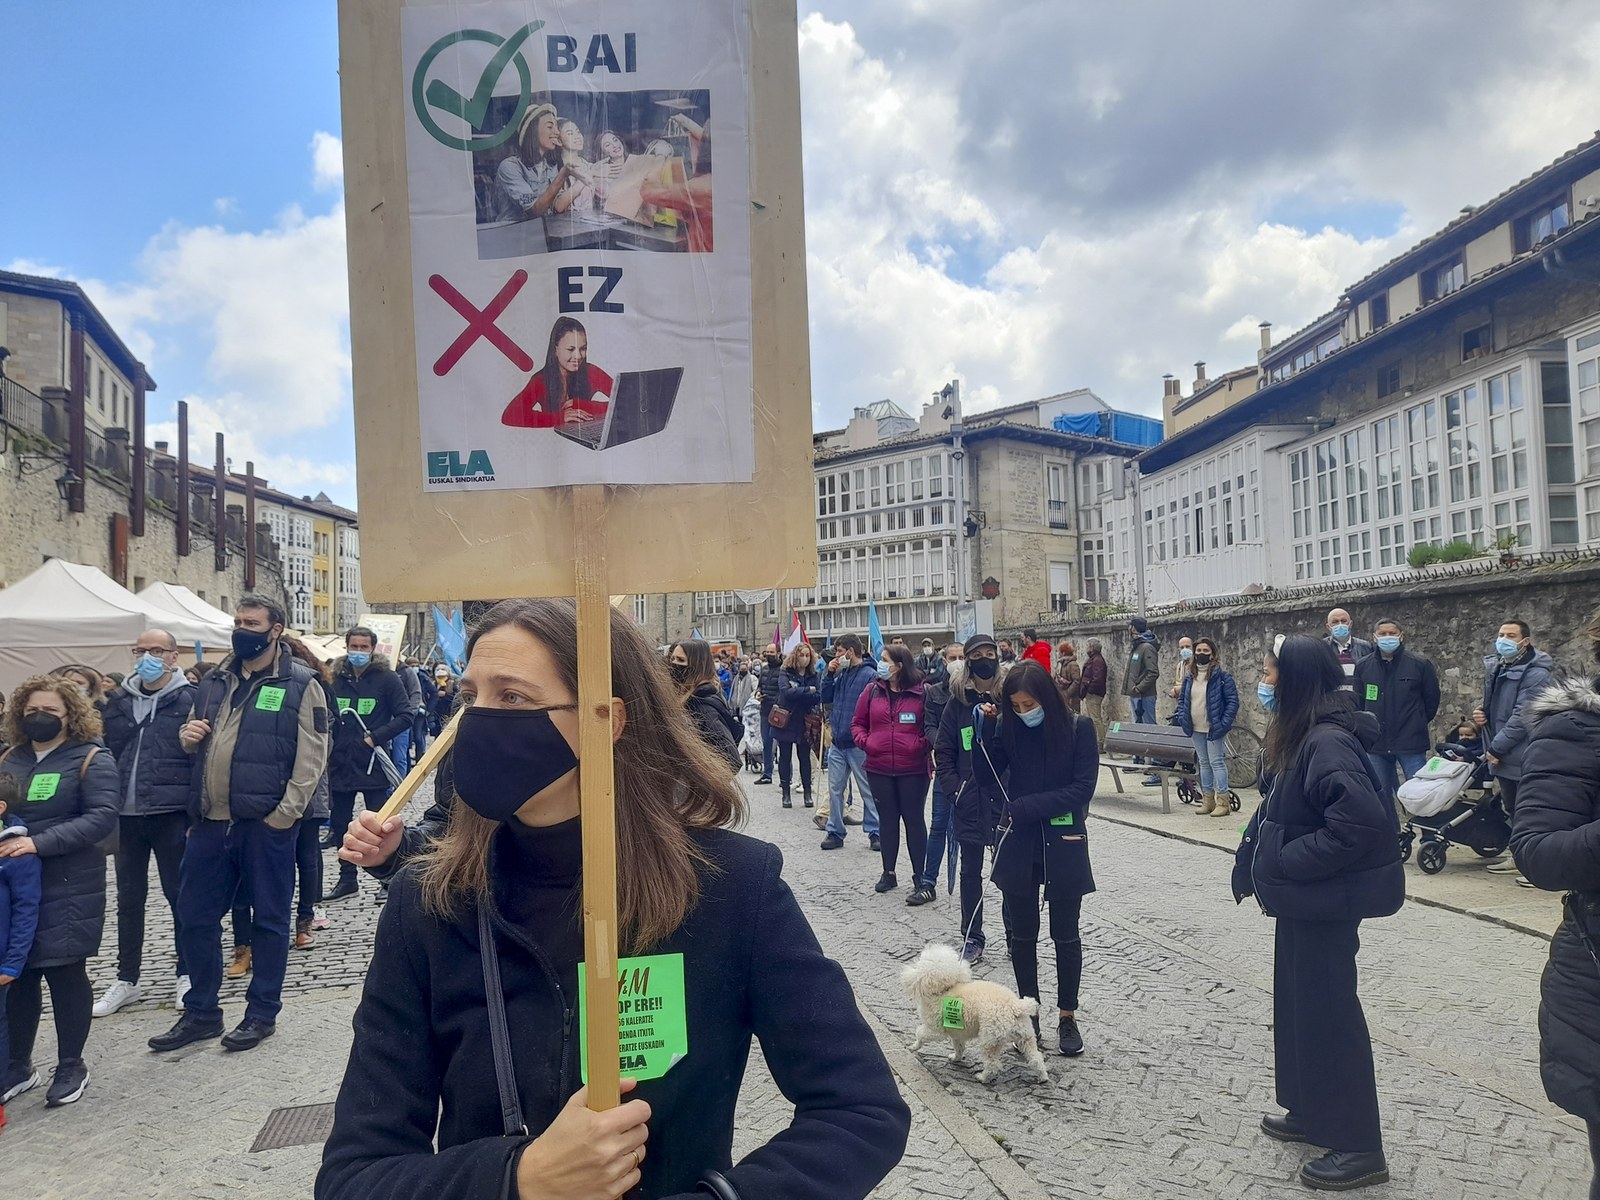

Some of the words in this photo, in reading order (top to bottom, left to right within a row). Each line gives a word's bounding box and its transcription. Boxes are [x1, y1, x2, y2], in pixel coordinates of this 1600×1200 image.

[546, 32, 637, 73] BAI
[558, 266, 625, 314] EZ
[427, 450, 495, 477] ELA
[618, 1000, 632, 1014] OP
[634, 997, 663, 1012] ERE!!
[626, 1014, 654, 1026] KALERATZE
[619, 1029, 637, 1040] DENDA
[637, 1027, 655, 1038] ITXITA
[619, 1042, 638, 1053] ERATZE
[638, 1039, 665, 1051] EUSKADIN
[619, 1054, 647, 1069] ELA
